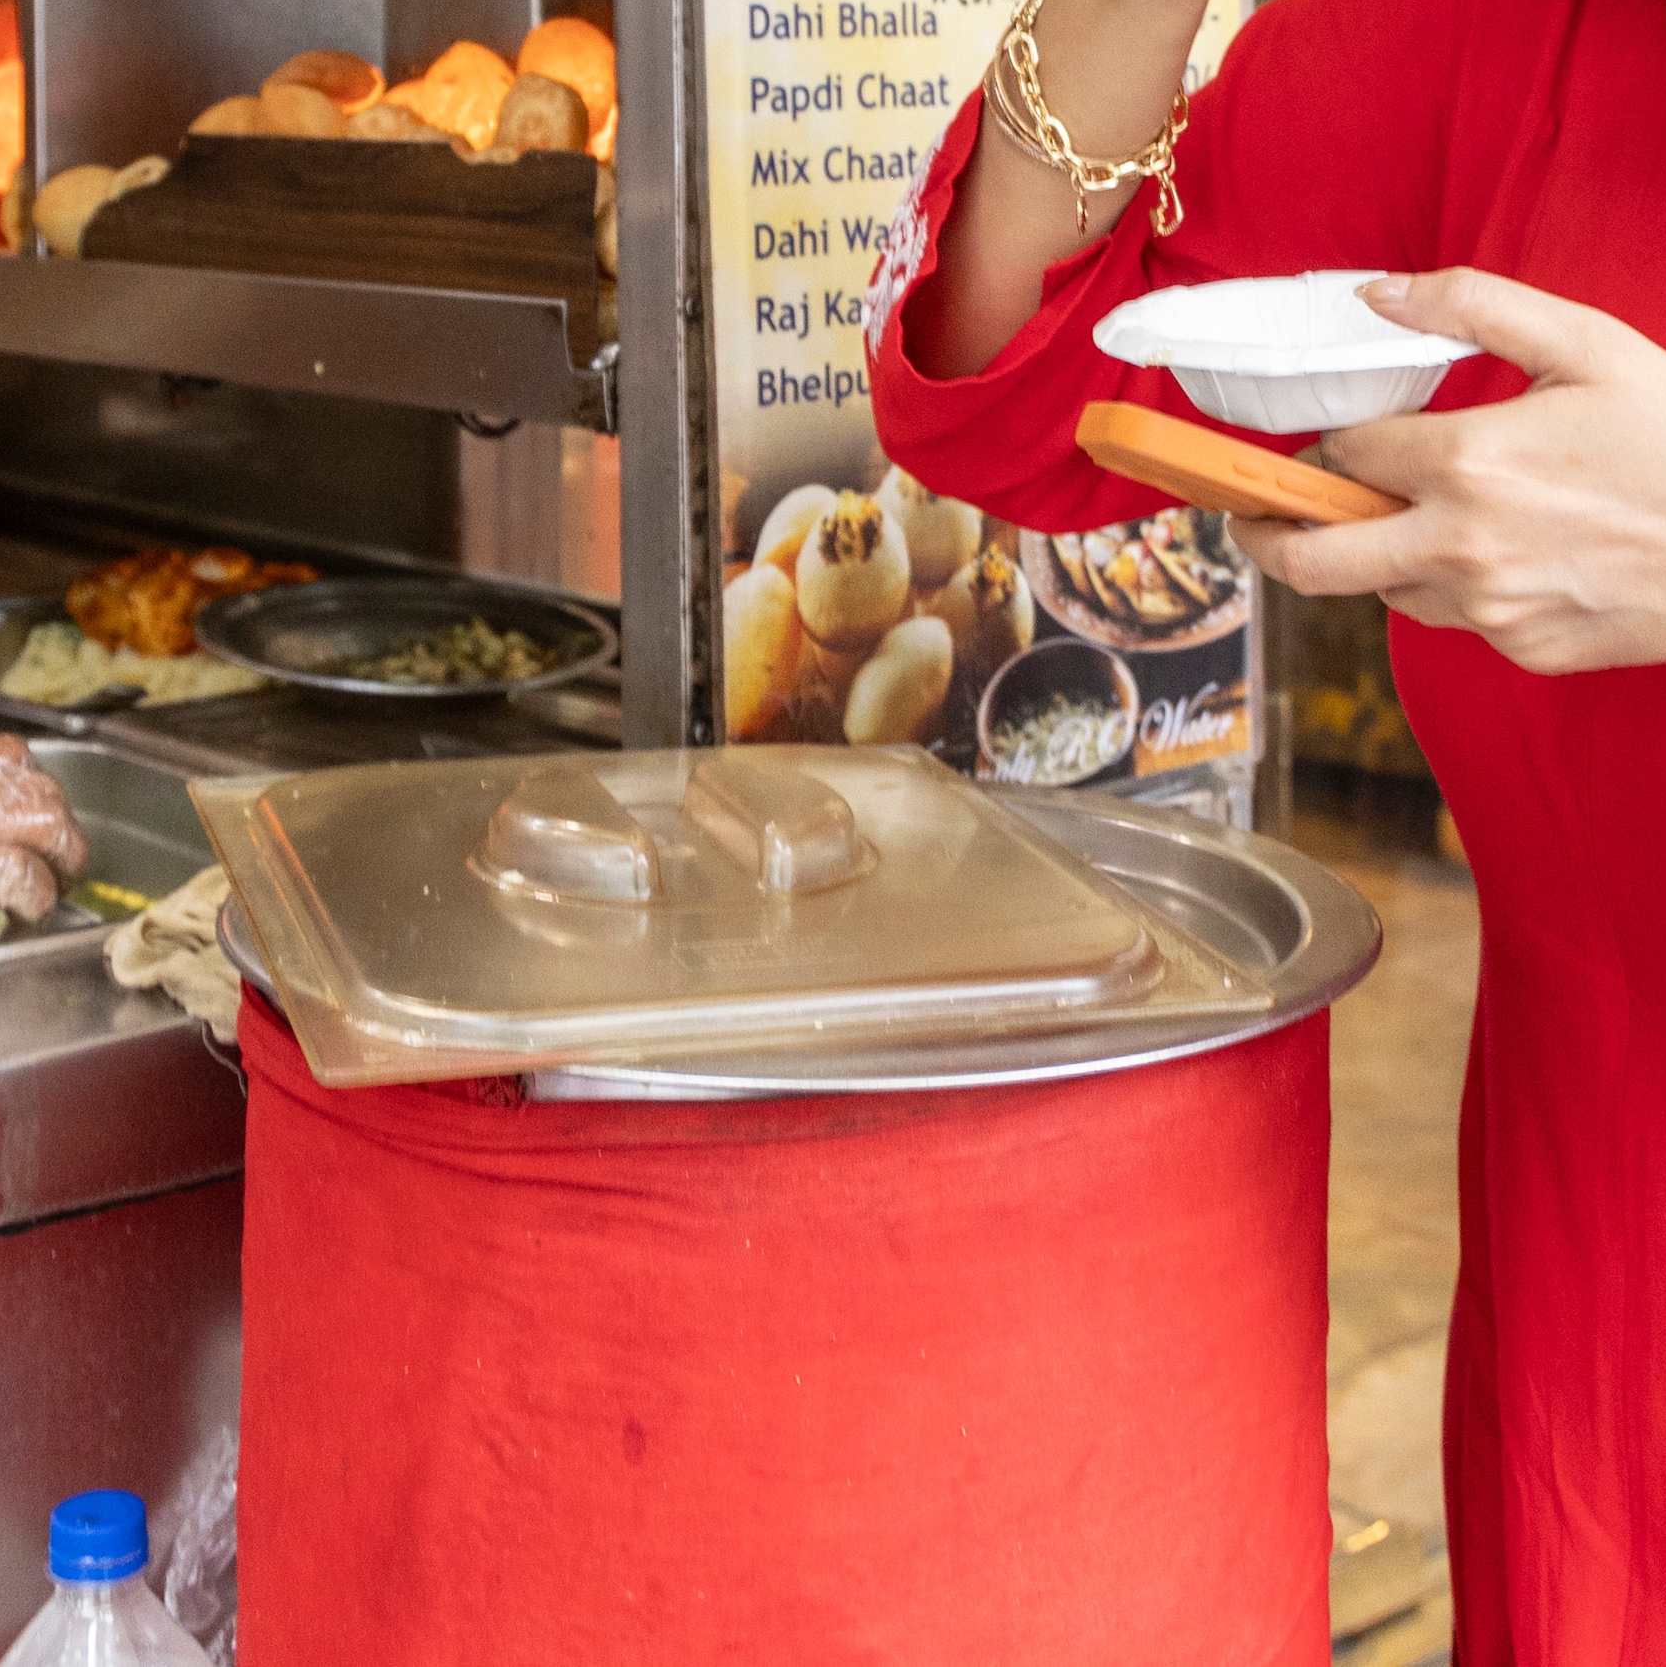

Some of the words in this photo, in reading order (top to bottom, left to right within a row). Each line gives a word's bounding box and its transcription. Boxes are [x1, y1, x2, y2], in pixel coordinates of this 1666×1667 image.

[748, 3, 823, 40] Dahi
[839, 2, 939, 38] Bhalla
[750, 74, 842, 121] Papdi
[856, 73, 950, 110] Chaat
[751, 148, 810, 187] Mix
[823, 145, 917, 183] Chaat
[754, 219, 829, 260] Dahi
[756, 291, 810, 340] Raj
